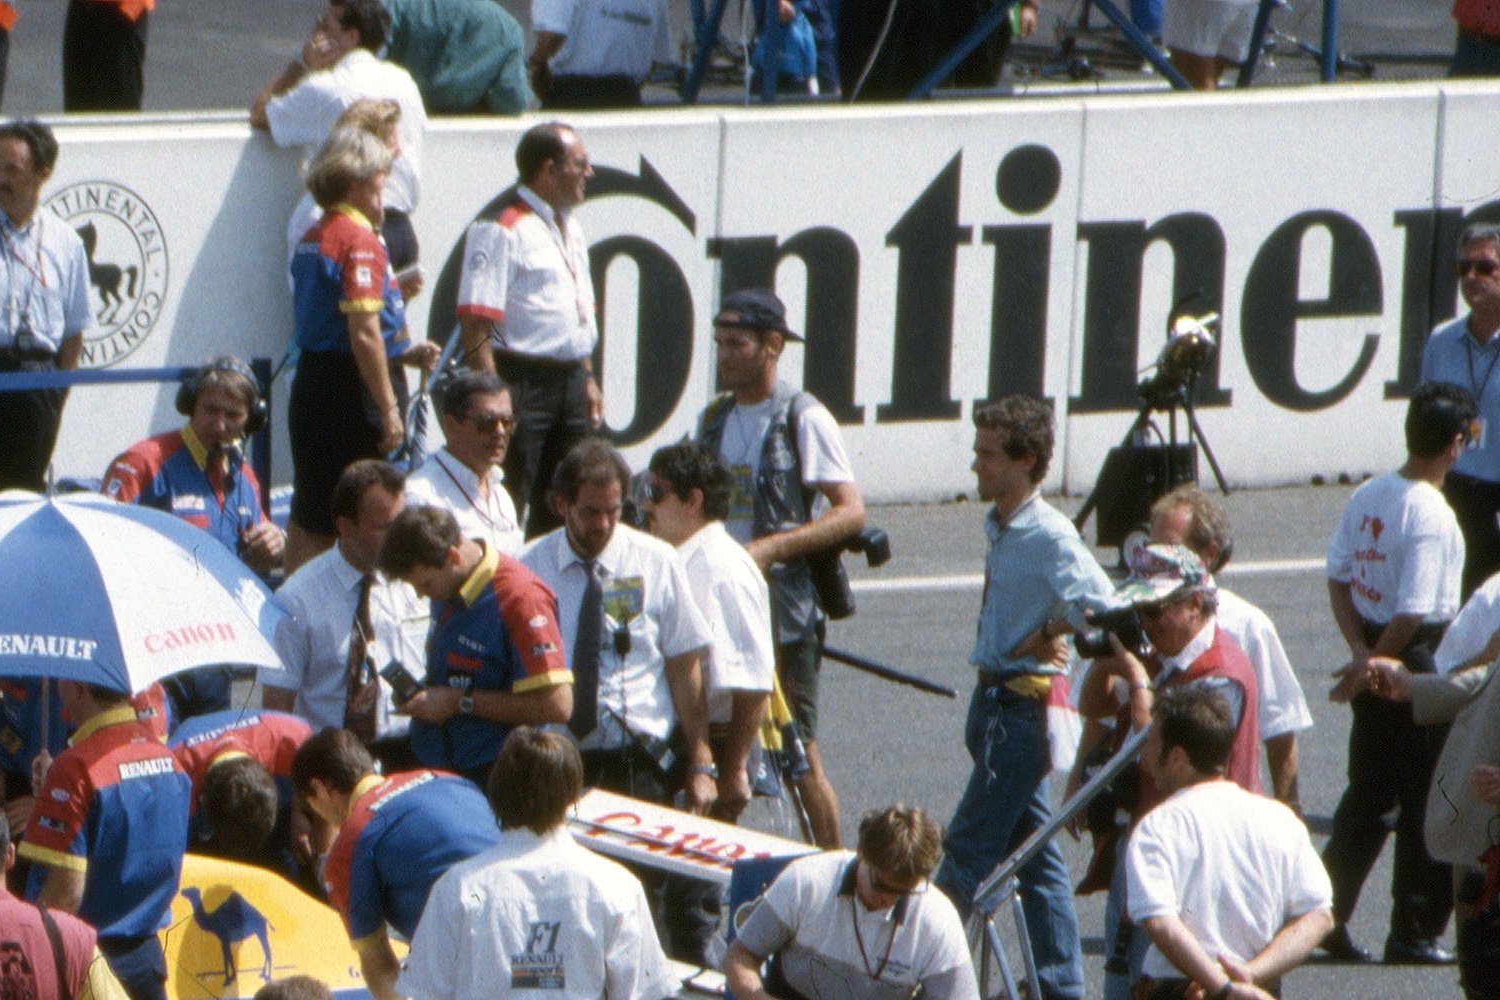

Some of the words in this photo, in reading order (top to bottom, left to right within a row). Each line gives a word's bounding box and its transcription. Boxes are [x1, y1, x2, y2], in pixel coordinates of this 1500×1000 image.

[119, 757, 175, 781] RENAULT
[525, 920, 561, 955] F1
[510, 953, 564, 964] RENAULT
